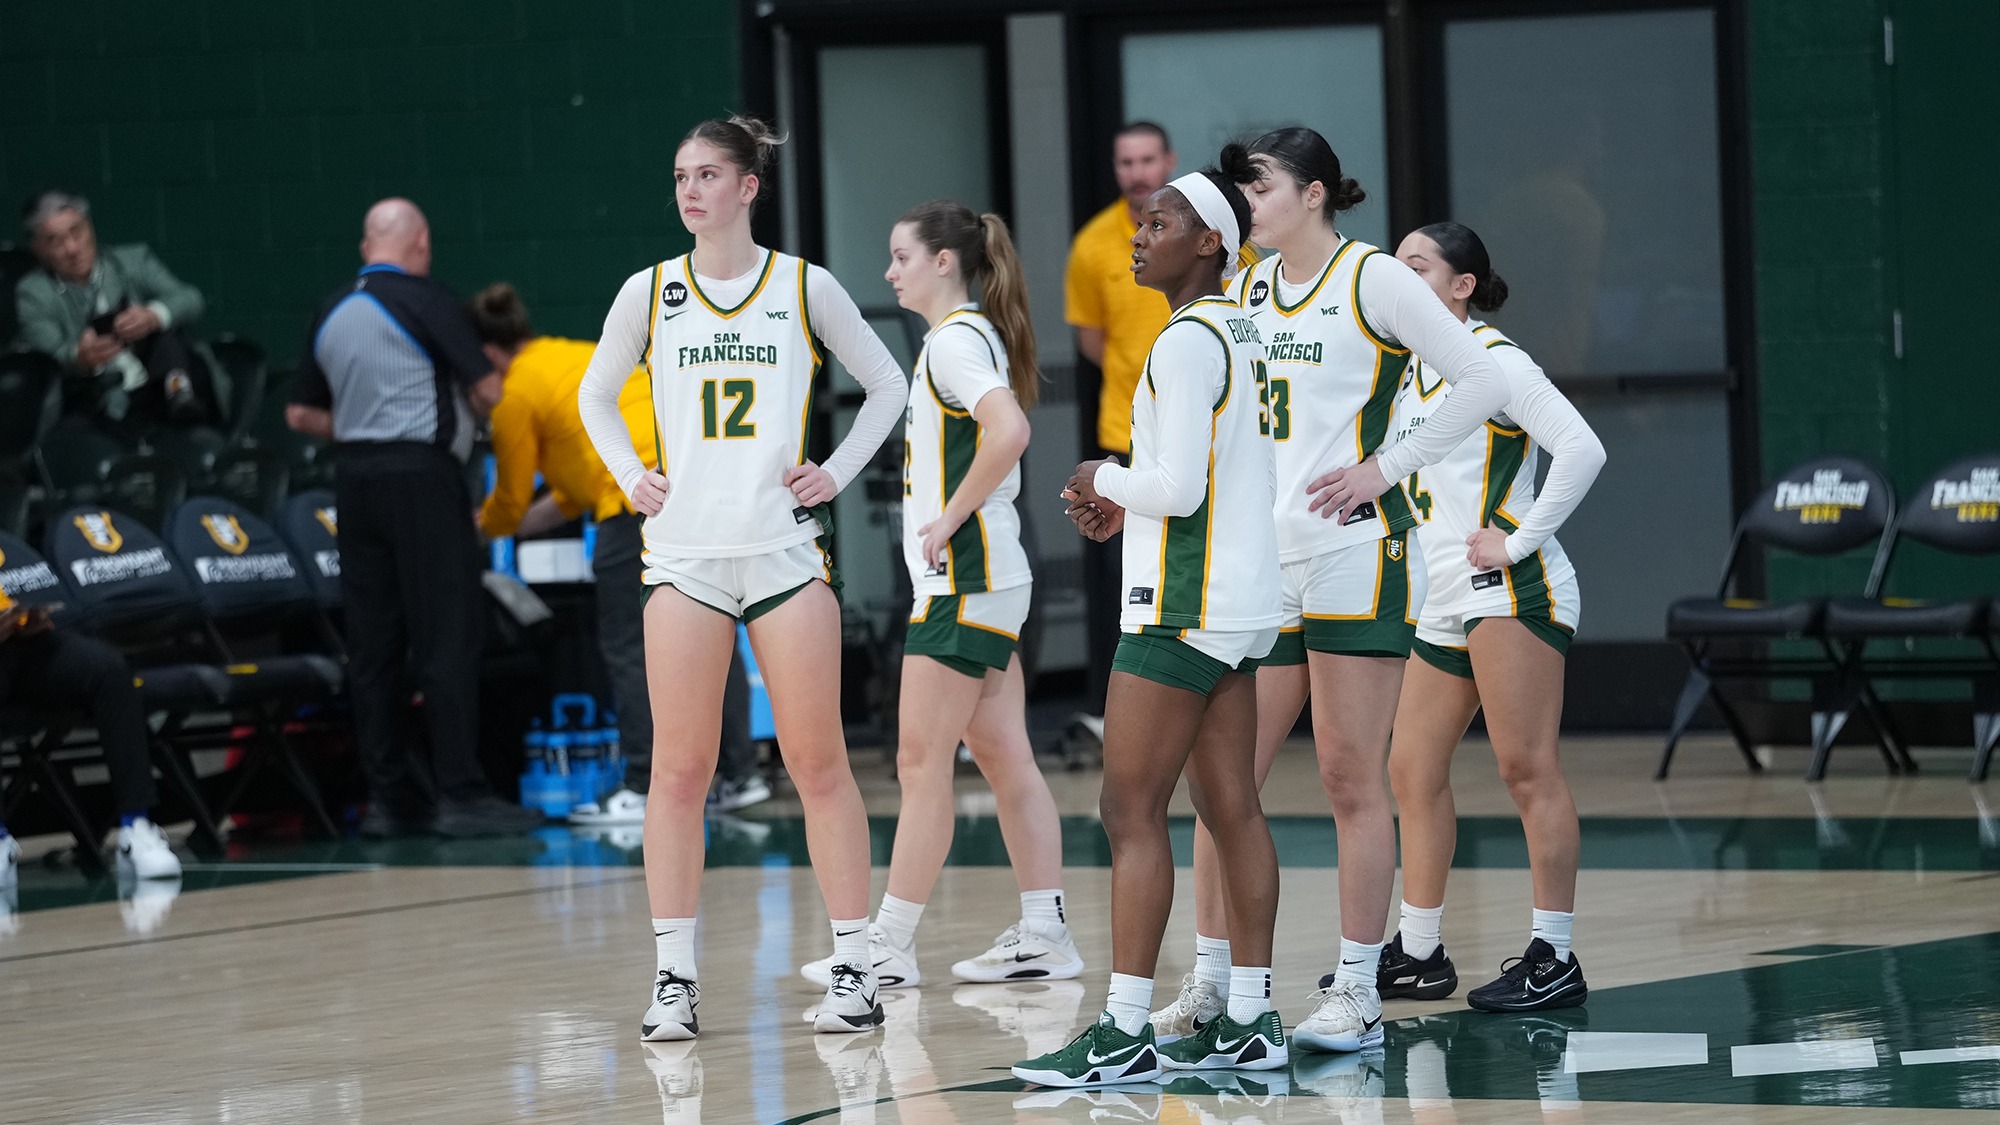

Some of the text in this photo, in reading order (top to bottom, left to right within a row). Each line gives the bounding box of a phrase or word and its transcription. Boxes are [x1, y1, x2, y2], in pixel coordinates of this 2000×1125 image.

[664, 289, 686, 301] LW
[1251, 288, 1267, 300] LW
[766, 311, 789, 320] WCC
[714, 333, 741, 343] SAN
[1273, 332, 1296, 343] SAN
[678, 345, 778, 369] FRANCISCO
[1265, 342, 1323, 364] NCISCO
[700, 377, 757, 440] 12
[1774, 480, 1870, 511] FRANCISCO
